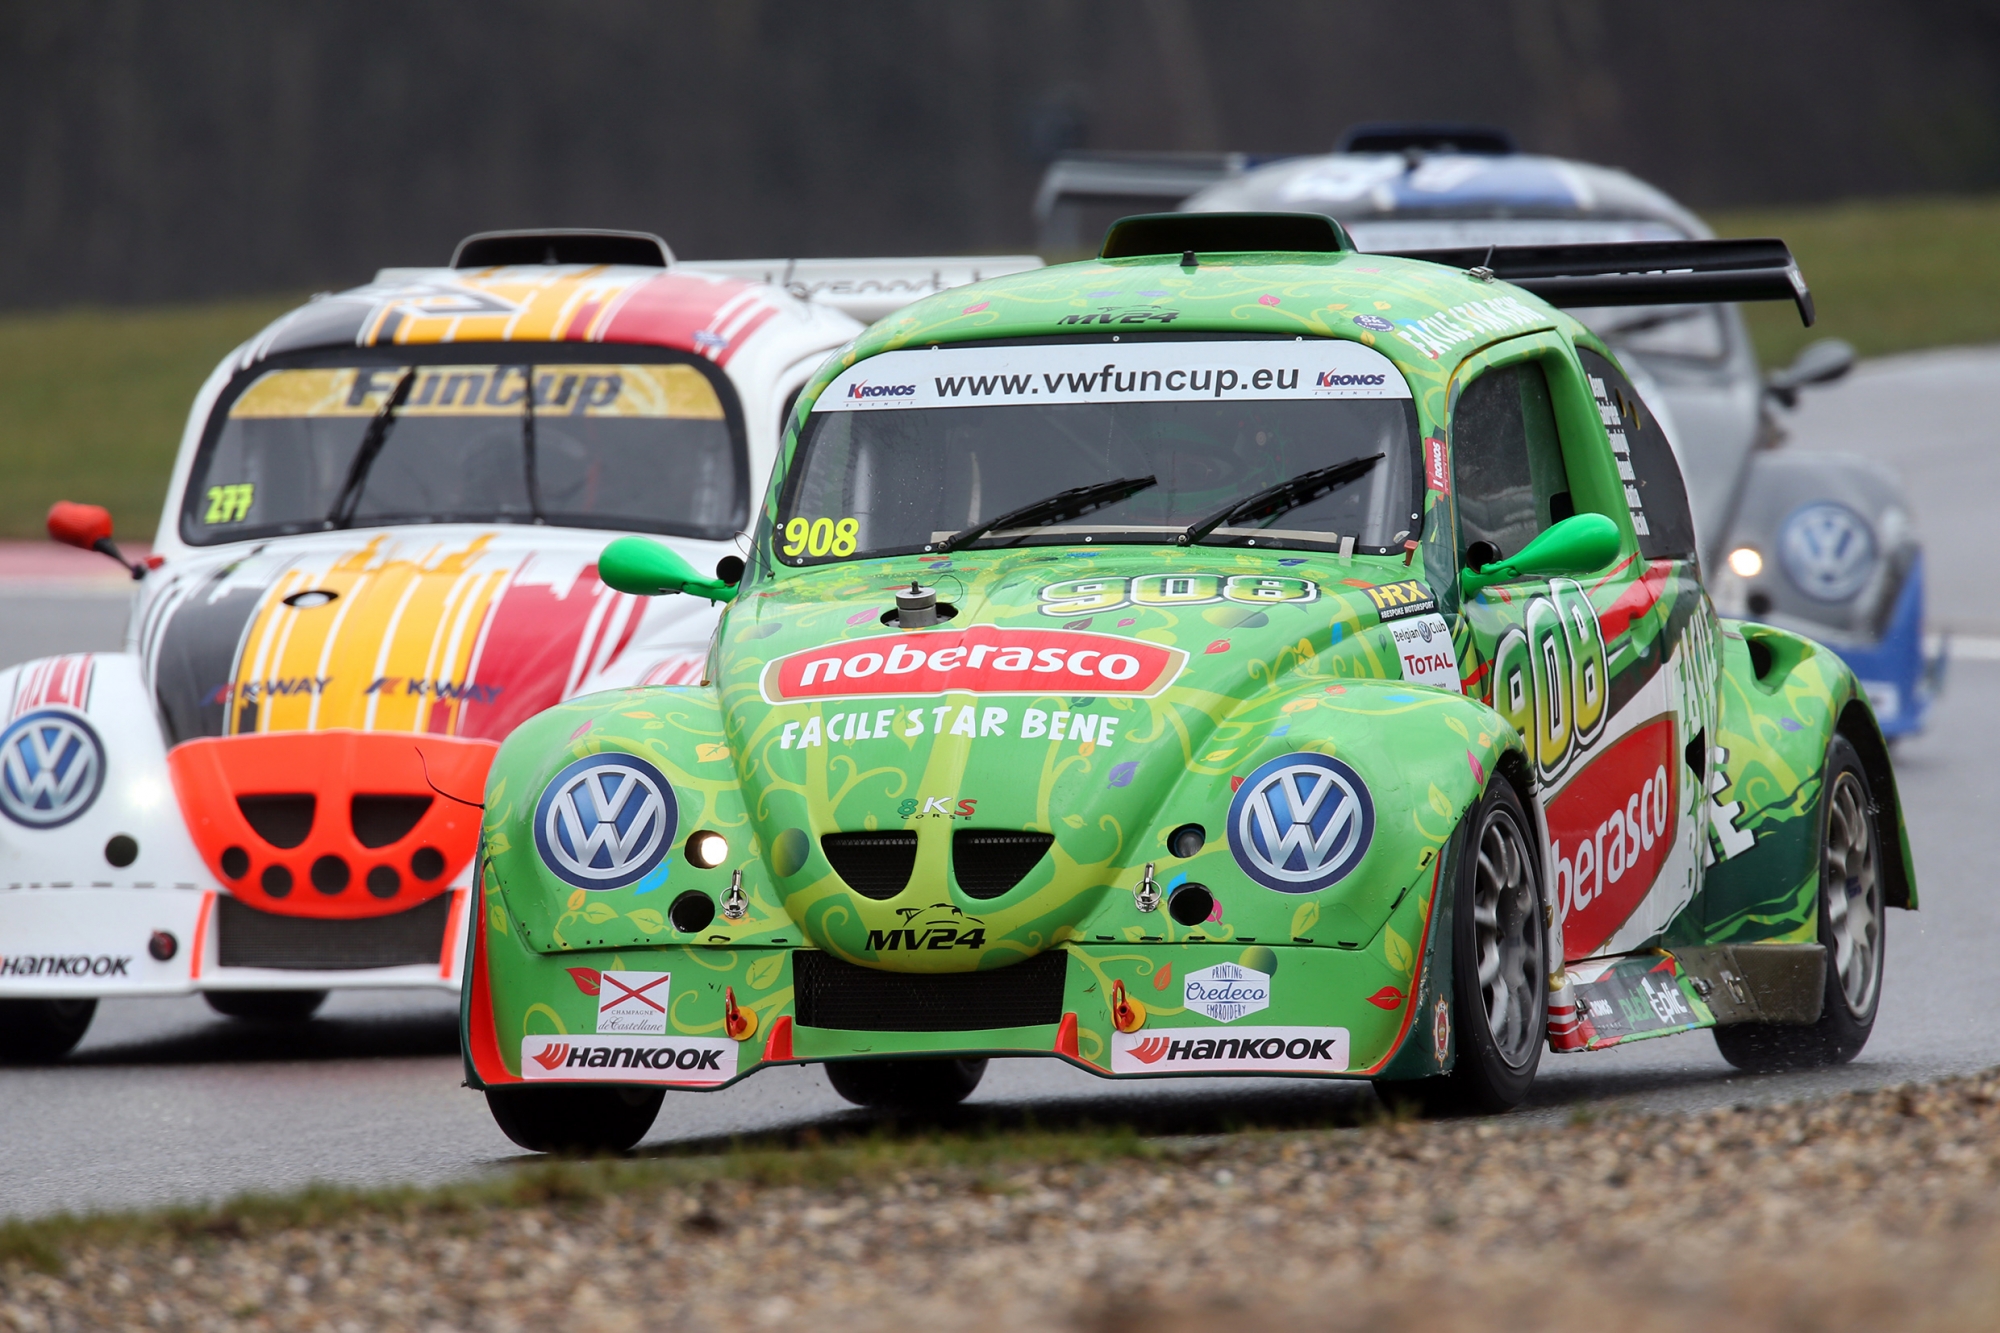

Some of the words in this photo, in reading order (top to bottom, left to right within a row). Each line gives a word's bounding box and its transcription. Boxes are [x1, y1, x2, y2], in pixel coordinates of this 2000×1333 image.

[1057, 312, 1180, 325] MV24
[935, 364, 1299, 397] www.vwfuncup.eu
[1316, 367, 1385, 387] KRONOS
[847, 380, 916, 399] KRONOS
[203, 482, 254, 524] 277
[783, 517, 859, 557] 908
[1038, 573, 1321, 617] 908
[1368, 581, 1428, 609] HRX
[1404, 601, 1434, 614] MOTORSPORT
[1393, 628, 1420, 643] Belgian
[1429, 621, 1446, 634] Club
[800, 644, 1140, 687] noberasco
[1404, 652, 1453, 676] TOTAL
[1493, 577, 1609, 785] 908
[781, 708, 895, 750] FACILE
[904, 705, 1008, 739] STAR
[1020, 708, 1119, 747] BENE
[897, 796, 977, 816] 8KS
[901, 813, 972, 821] CORSE
[546, 764, 667, 879] VW
[1239, 764, 1363, 882] VW
[865, 928, 986, 951] MV24
[1212, 965, 1243, 979] PRINTING
[1186, 982, 1267, 1001] Credeco
[610, 1016, 663, 1031] Castellane
[1206, 1004, 1247, 1021] EMBROIDERY
